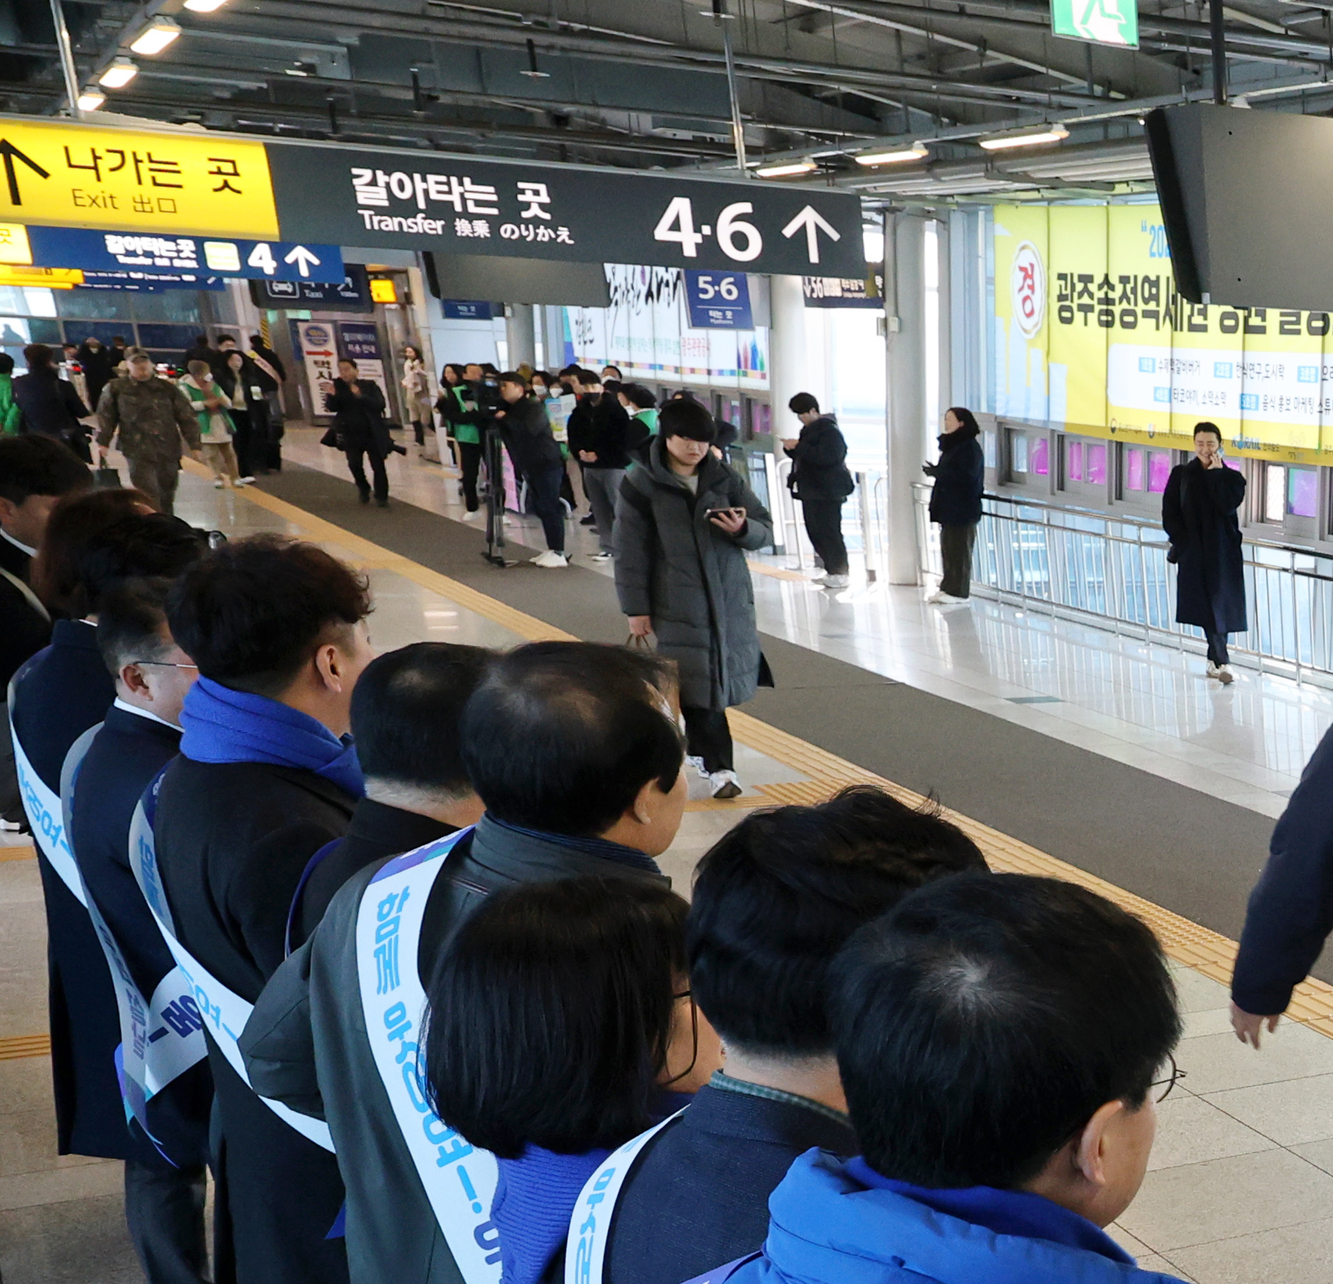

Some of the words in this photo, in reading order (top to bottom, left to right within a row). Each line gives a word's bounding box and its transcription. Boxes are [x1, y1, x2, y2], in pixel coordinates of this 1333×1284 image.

[63, 145, 183, 189] 나가는
[207, 157, 242, 194] 곳
[71, 188, 119, 210] Exit
[132, 194, 177, 214] 出口
[351, 167, 499, 215] 갈아타는
[516, 181, 552, 220] 곳
[357, 209, 445, 235] Transfer
[500, 223, 575, 245] のりかえ
[247, 243, 277, 275] 4
[1018, 262, 1036, 318] 경
[373, 884, 412, 996] 함께
